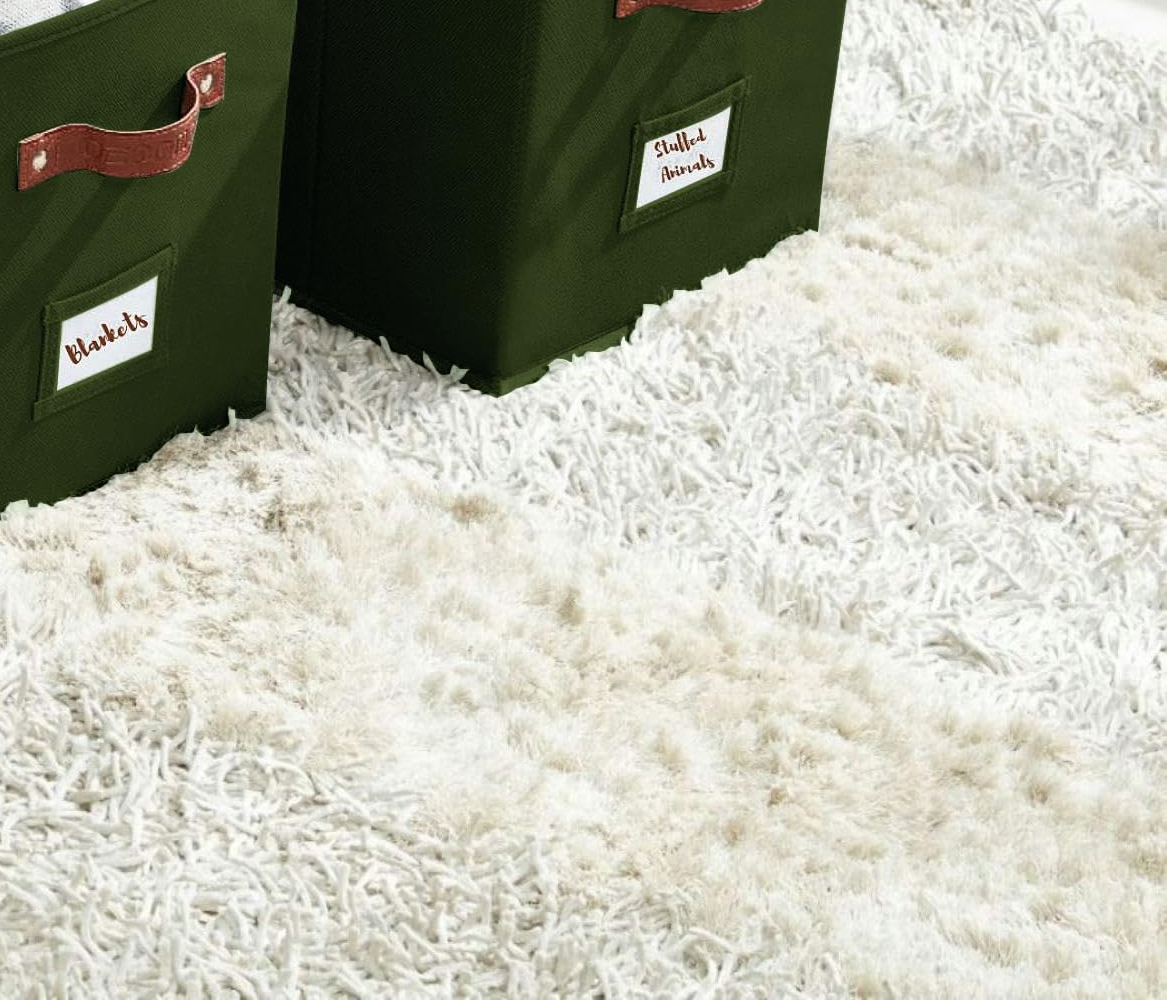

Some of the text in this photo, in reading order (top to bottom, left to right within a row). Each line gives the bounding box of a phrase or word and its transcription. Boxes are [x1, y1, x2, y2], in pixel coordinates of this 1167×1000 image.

[654, 128, 707, 158] Stuffed
[661, 154, 715, 183] Animals
[64, 312, 149, 365] Blankets
